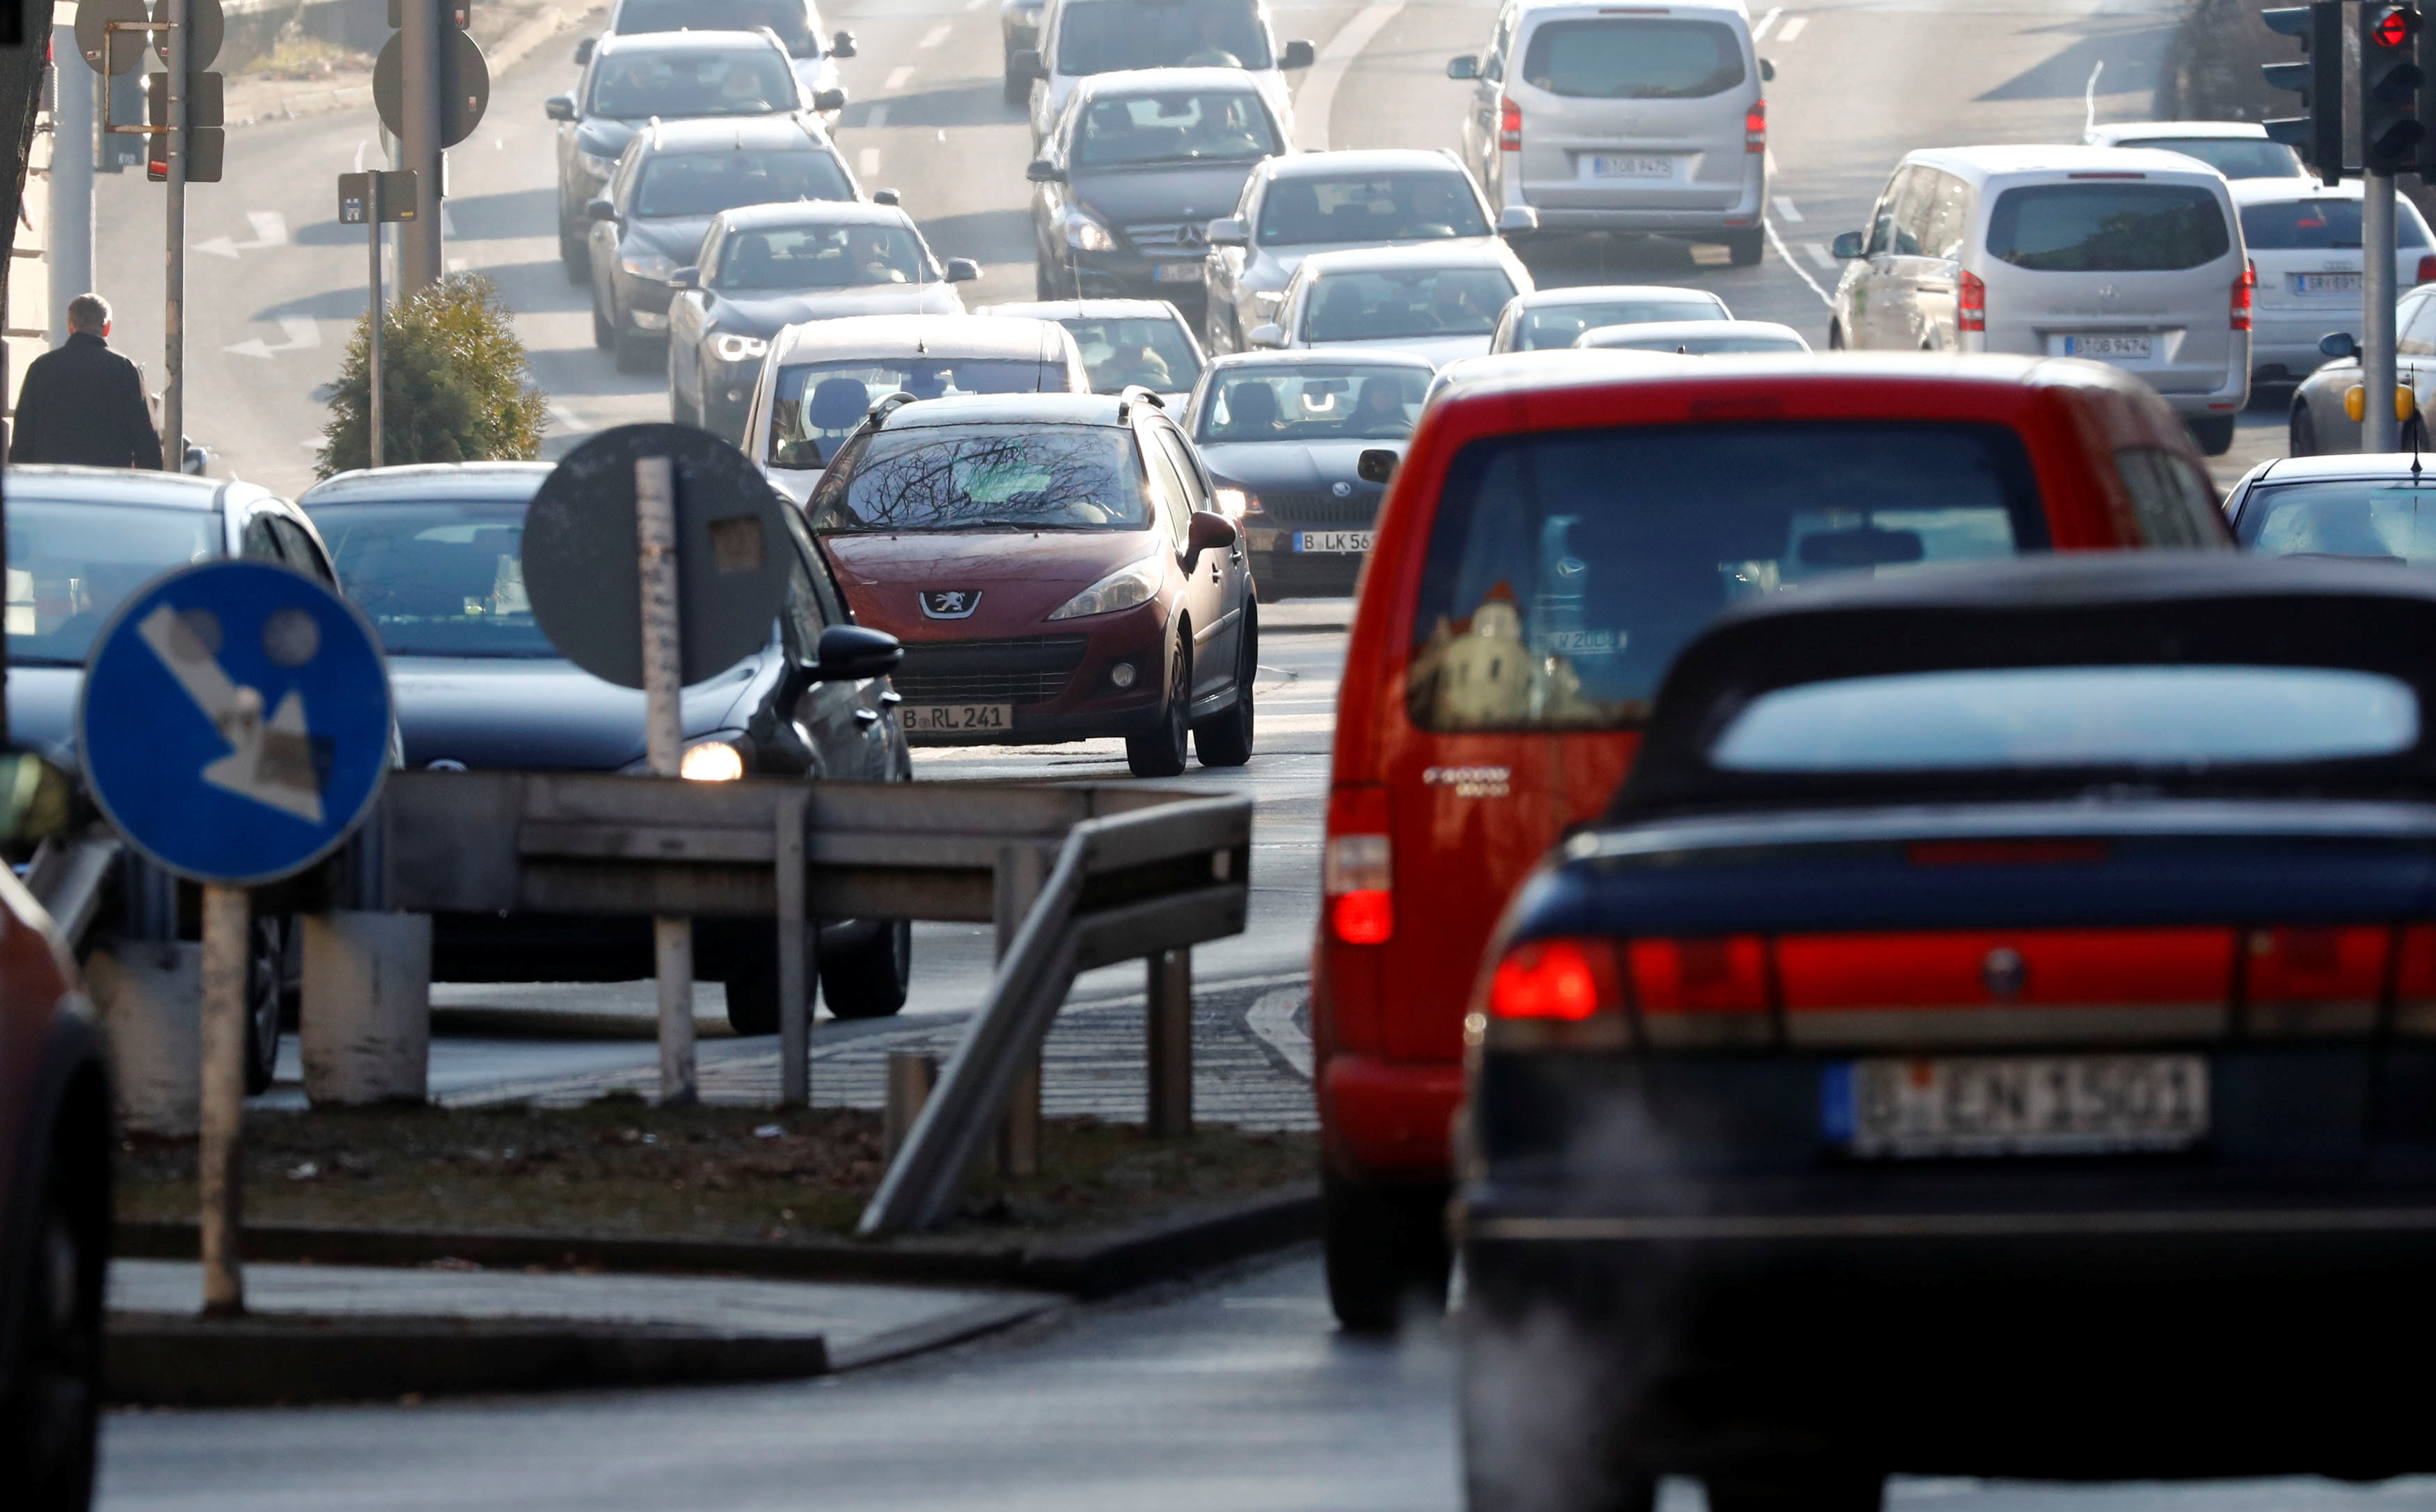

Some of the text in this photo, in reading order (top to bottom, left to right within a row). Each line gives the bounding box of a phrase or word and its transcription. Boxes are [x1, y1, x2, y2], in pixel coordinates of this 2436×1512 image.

[2114, 338, 2149, 352] 9474
[1304, 534, 1314, 550] B
[1325, 534, 1346, 550] LK
[903, 706, 1003, 729] B RL 241
